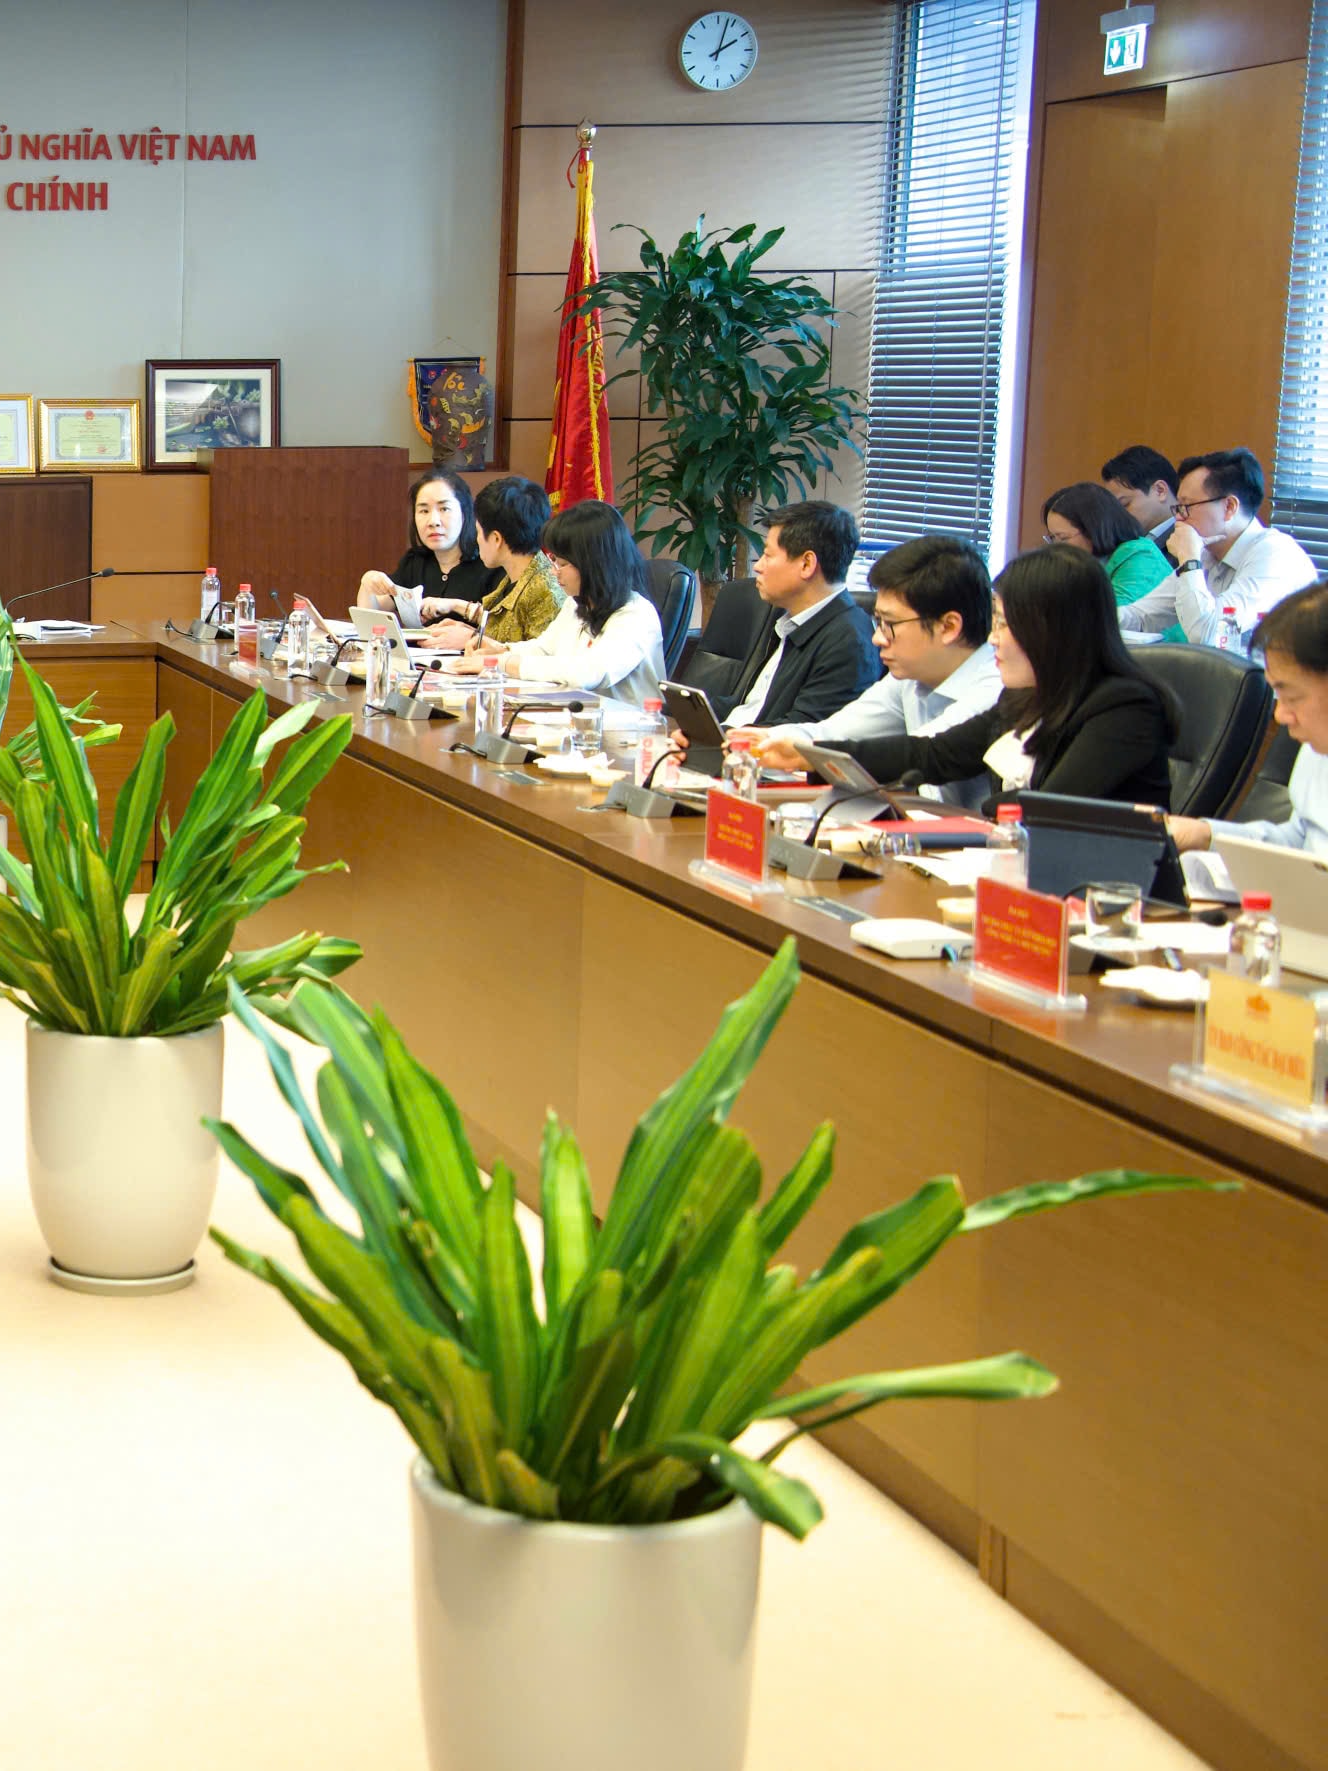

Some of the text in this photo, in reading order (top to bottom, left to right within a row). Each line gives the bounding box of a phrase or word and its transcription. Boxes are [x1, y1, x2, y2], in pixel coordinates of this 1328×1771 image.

[19, 127, 113, 161] NGHĨA
[118, 126, 181, 166] VIỆT
[187, 133, 257, 161] NAM
[6, 175, 109, 212] CHÍNH
